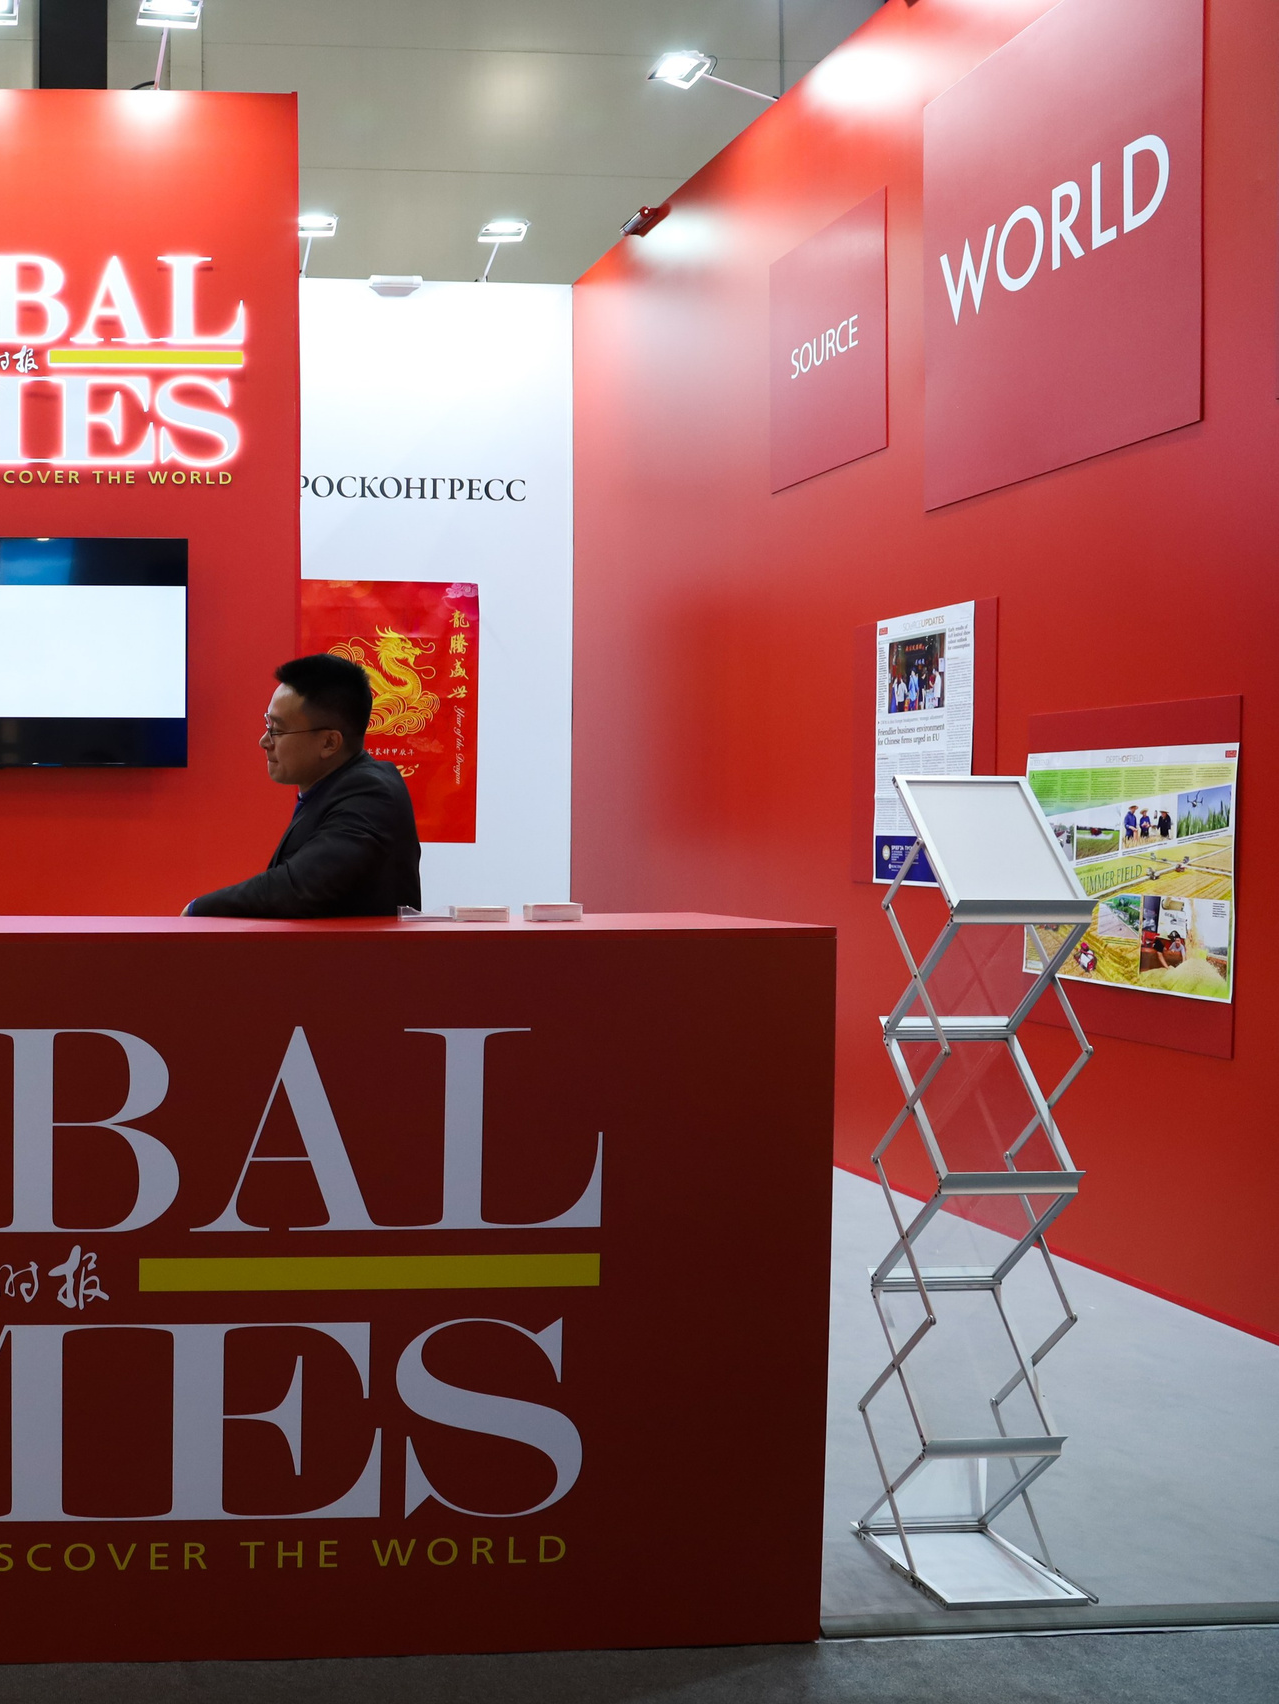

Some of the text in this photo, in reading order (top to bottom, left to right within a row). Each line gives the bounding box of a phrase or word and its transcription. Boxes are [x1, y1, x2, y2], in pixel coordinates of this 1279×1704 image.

[939, 134, 1170, 325] WORLD
[791, 314, 859, 380] SOURCE
[94, 471, 135, 484] THE
[149, 471, 232, 485] WORLD
[454, 705, 465, 727] Year
[897, 725, 916, 735] business
[916, 723, 945, 732] environment
[884, 736, 901, 746] Chinese
[452, 753, 465, 785] Dragon
[1080, 864, 1143, 894] UMMER FIELD
[240, 1541, 339, 1570] THE
[372, 1535, 568, 1567] WORLD
